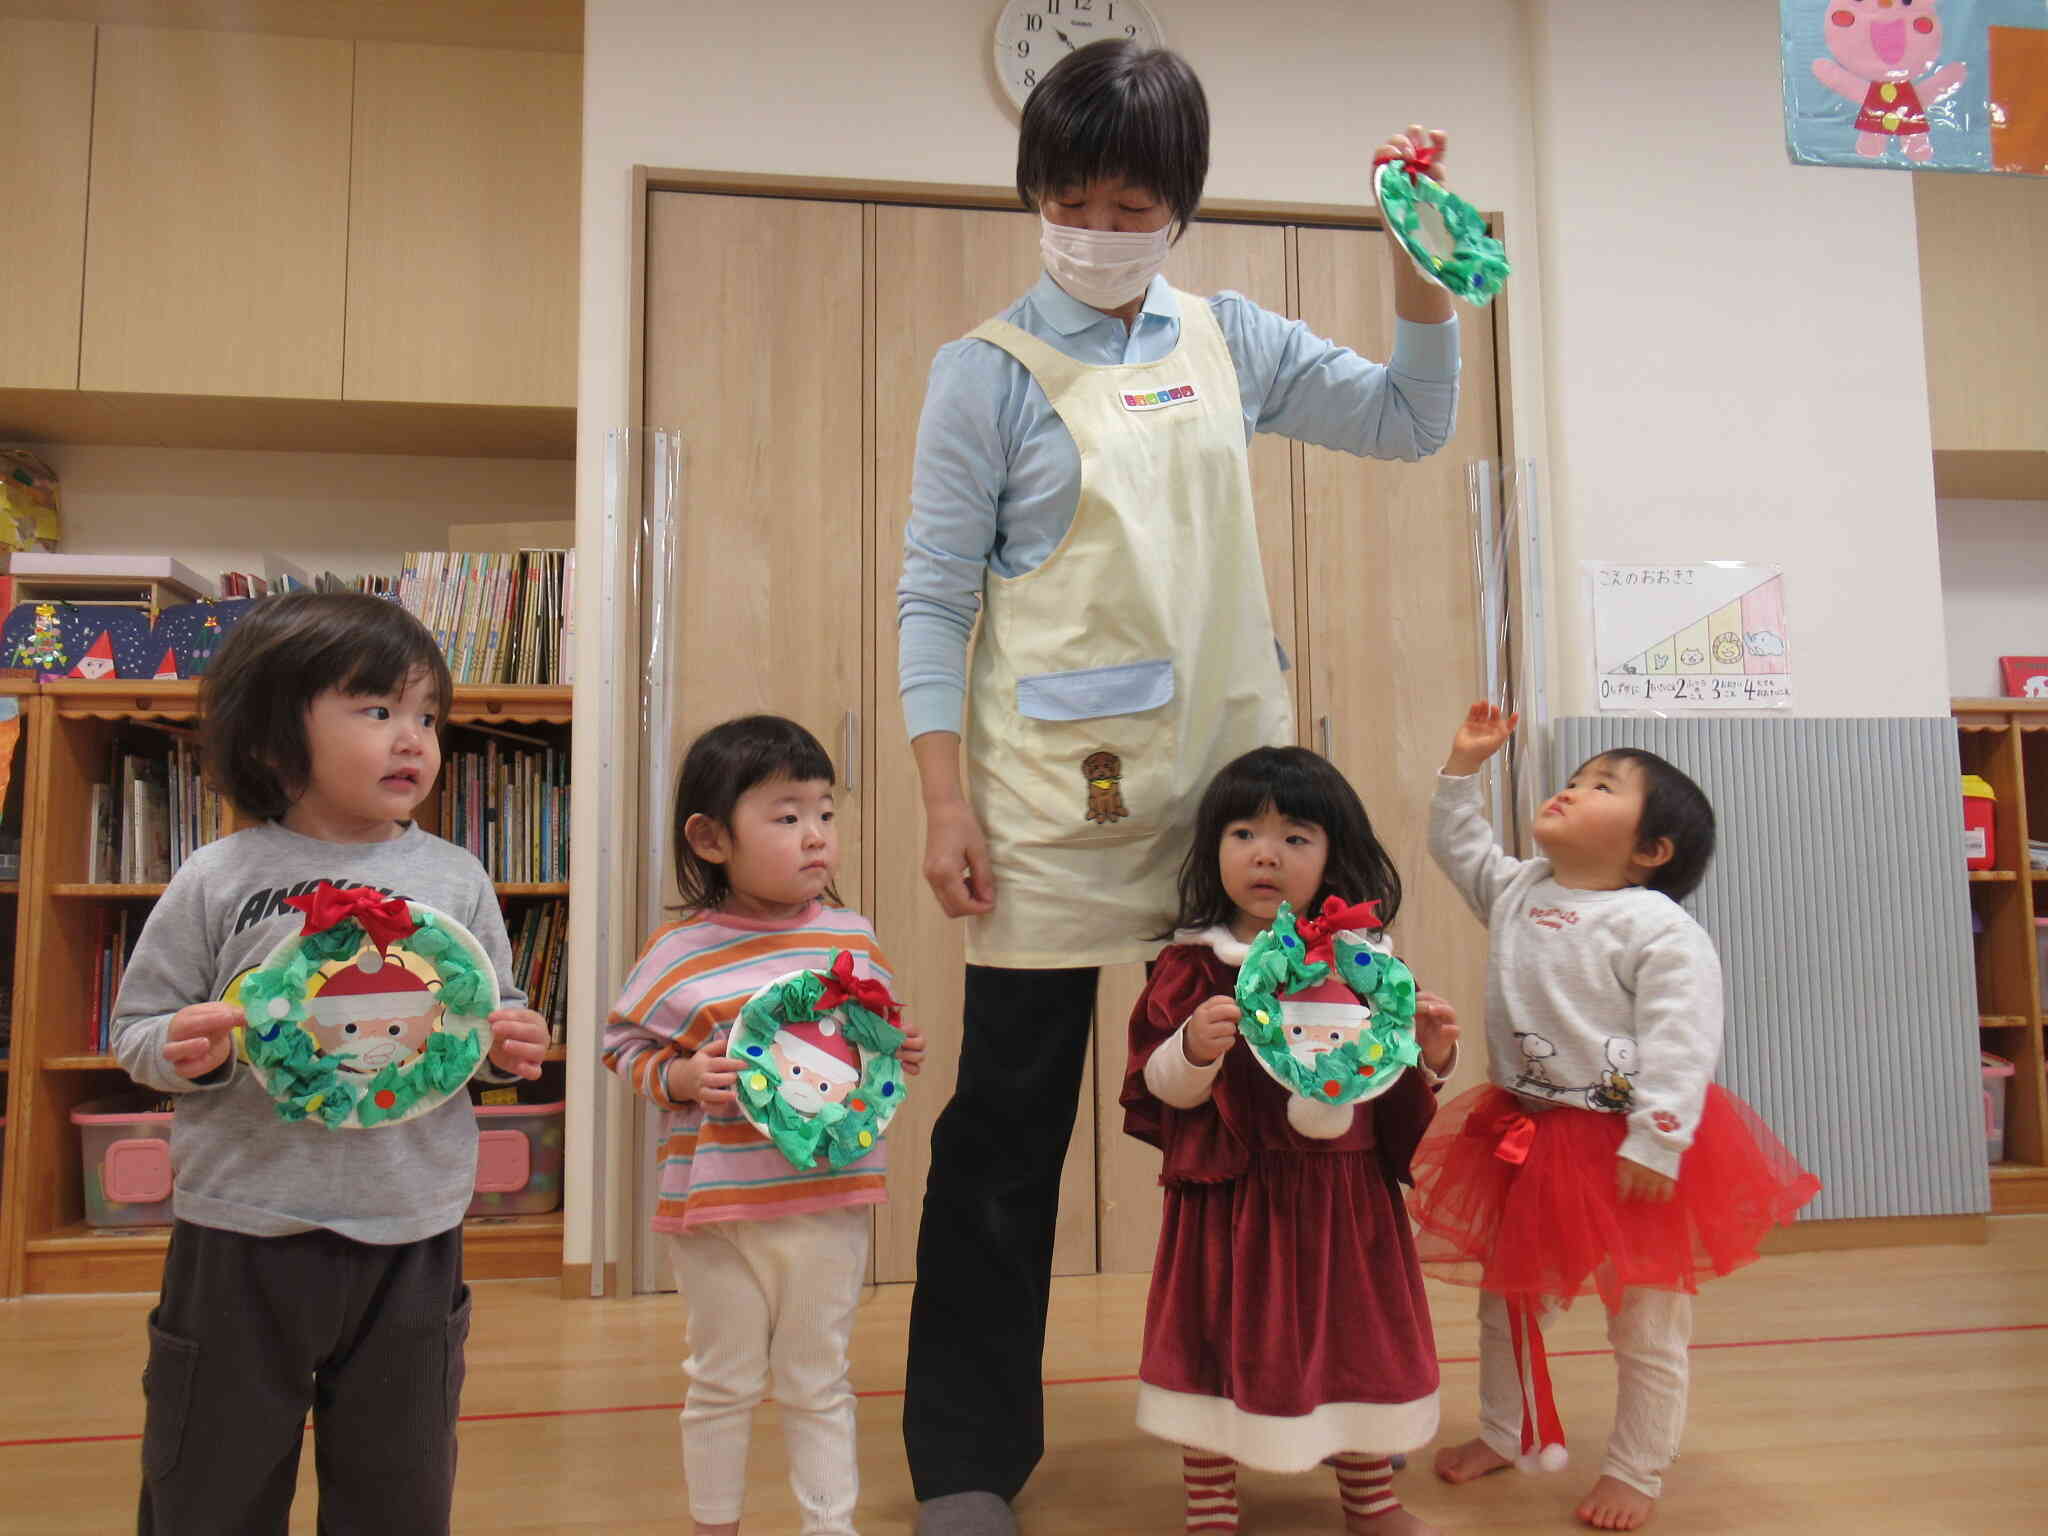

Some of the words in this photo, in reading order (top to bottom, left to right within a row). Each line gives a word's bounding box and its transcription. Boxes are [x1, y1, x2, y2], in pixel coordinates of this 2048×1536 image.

[1048, 0, 1059, 15] 11
[1107, 3, 1114, 21] 1
[1027, 14, 1042, 31] 10
[1018, 40, 1030, 57] 9
[1024, 69, 1036, 87] 8
[1599, 568, 1695, 587] こえのおおきさ
